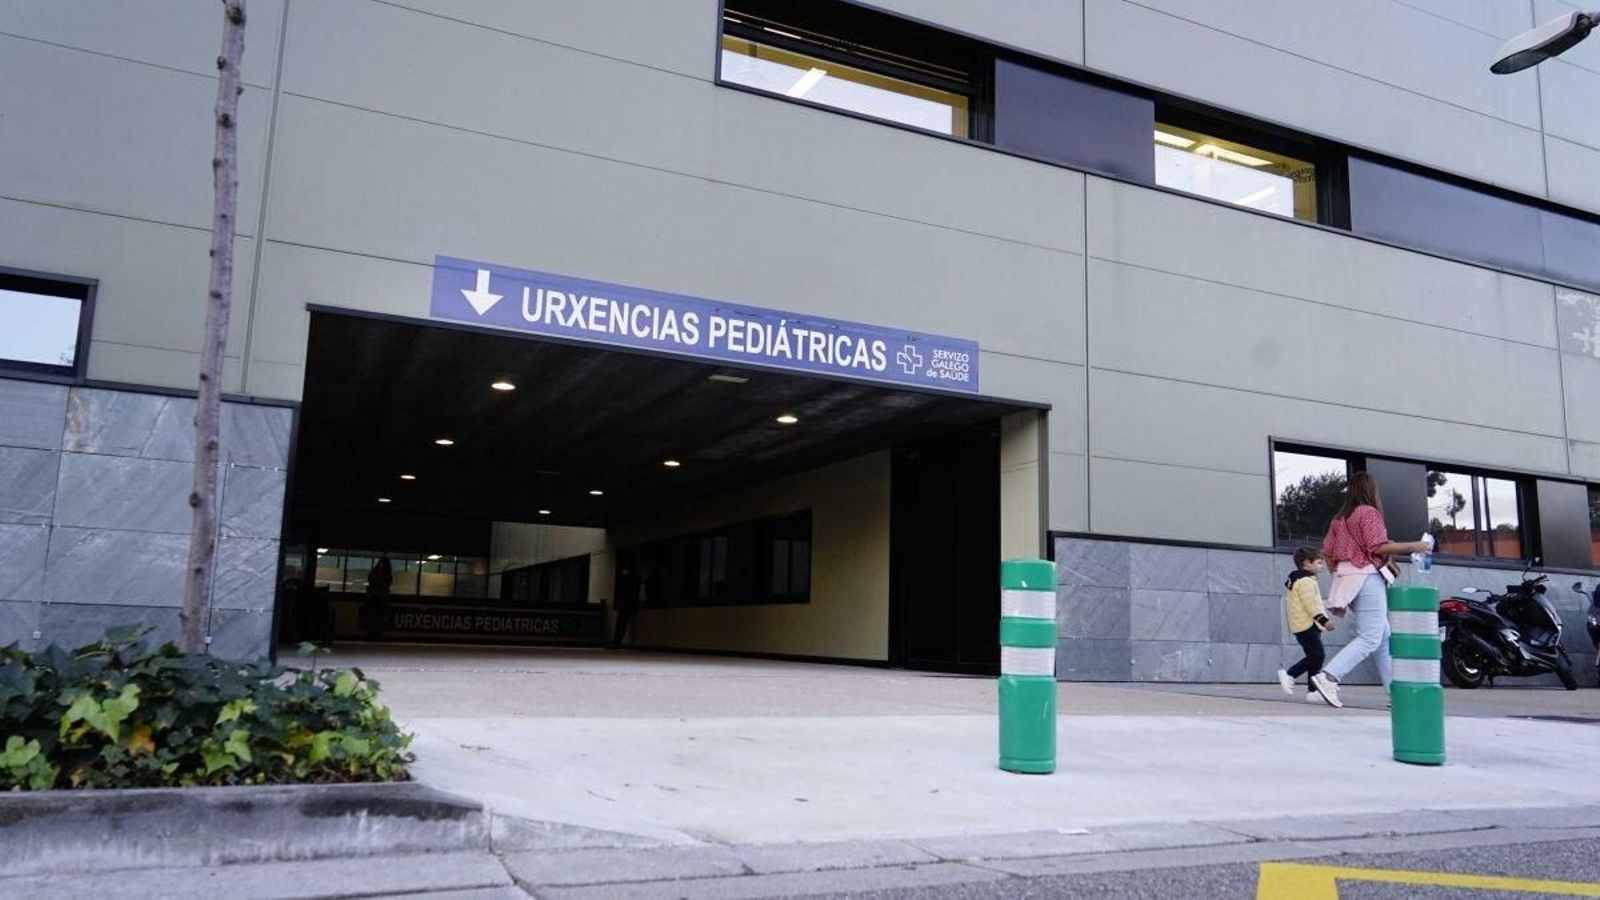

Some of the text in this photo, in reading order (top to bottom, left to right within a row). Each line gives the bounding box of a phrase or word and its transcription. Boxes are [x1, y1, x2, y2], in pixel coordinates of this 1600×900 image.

[521, 286, 887, 372] URXENCIAS PEDIÁTRICAS
[932, 349, 970, 363] SERVIZO
[926, 367, 938, 378] de
[931, 359, 969, 373] GALEGO
[395, 613, 472, 631] URXENCIAS
[475, 613, 559, 632] PEDIÁTRICAS
